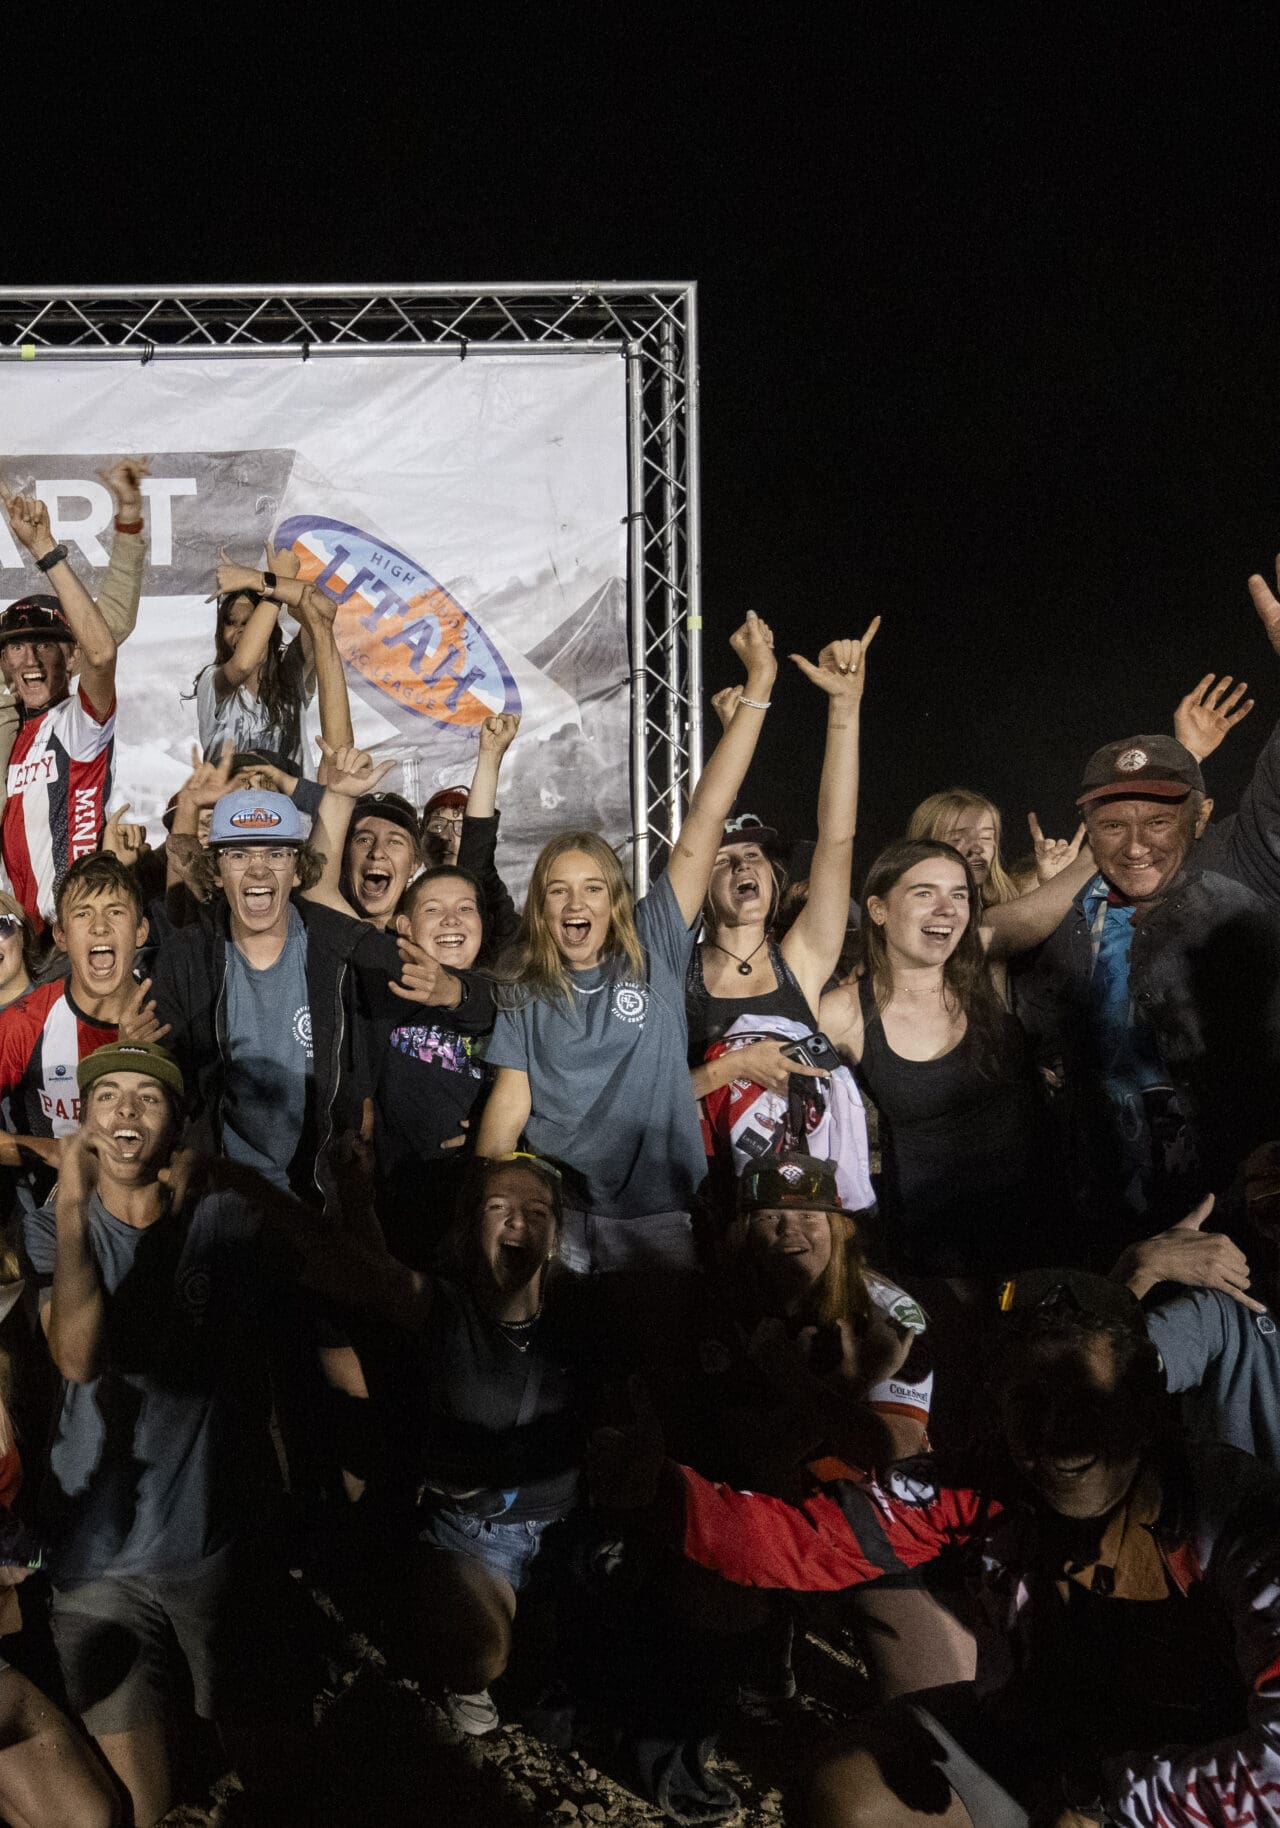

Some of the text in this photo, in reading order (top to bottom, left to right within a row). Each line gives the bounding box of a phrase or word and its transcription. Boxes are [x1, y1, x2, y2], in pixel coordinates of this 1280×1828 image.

[370, 552, 417, 585] HIGH
[316, 544, 487, 712] UTAH
[15, 756, 53, 788] CITY
[239, 813, 273, 824] UTAH
